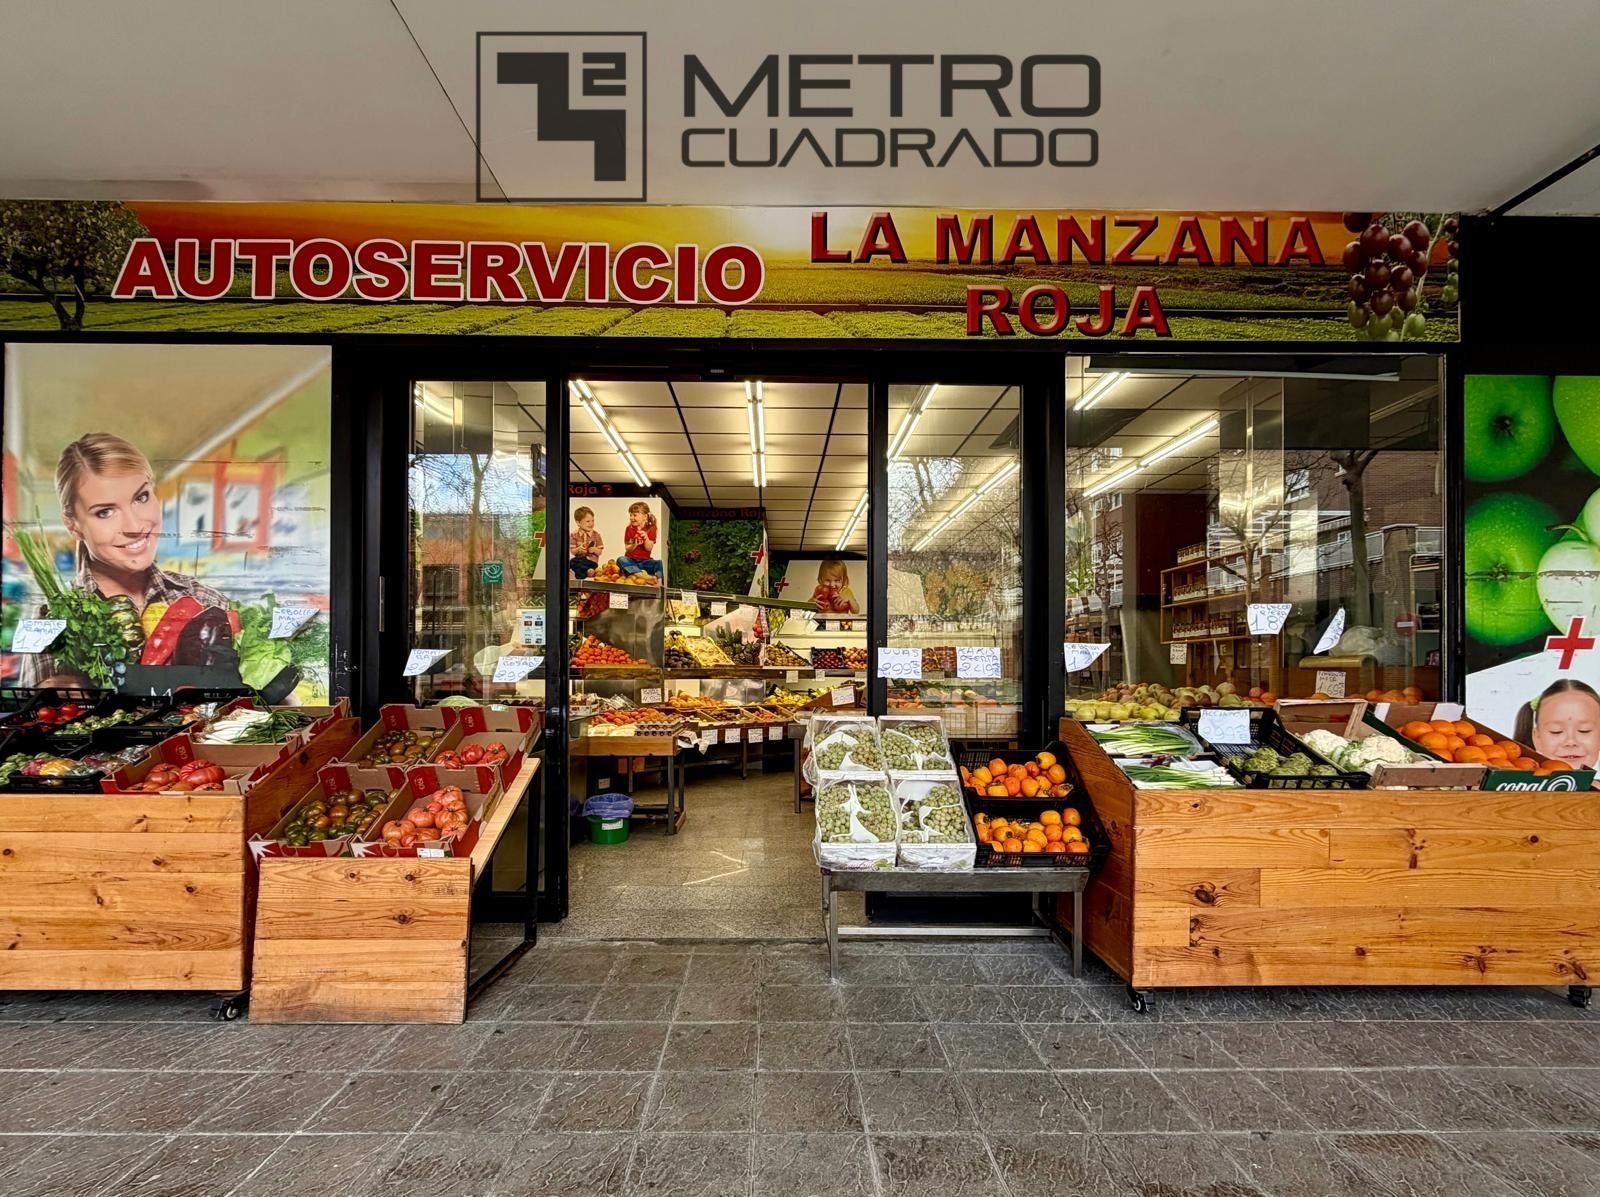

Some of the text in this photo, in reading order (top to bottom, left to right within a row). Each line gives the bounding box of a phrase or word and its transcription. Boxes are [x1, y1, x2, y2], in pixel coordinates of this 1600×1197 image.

[810, 211, 1326, 267] LA MANZANA
[111, 238, 765, 305] AUTOSERVICIO
[965, 284, 1173, 337] ROJA
